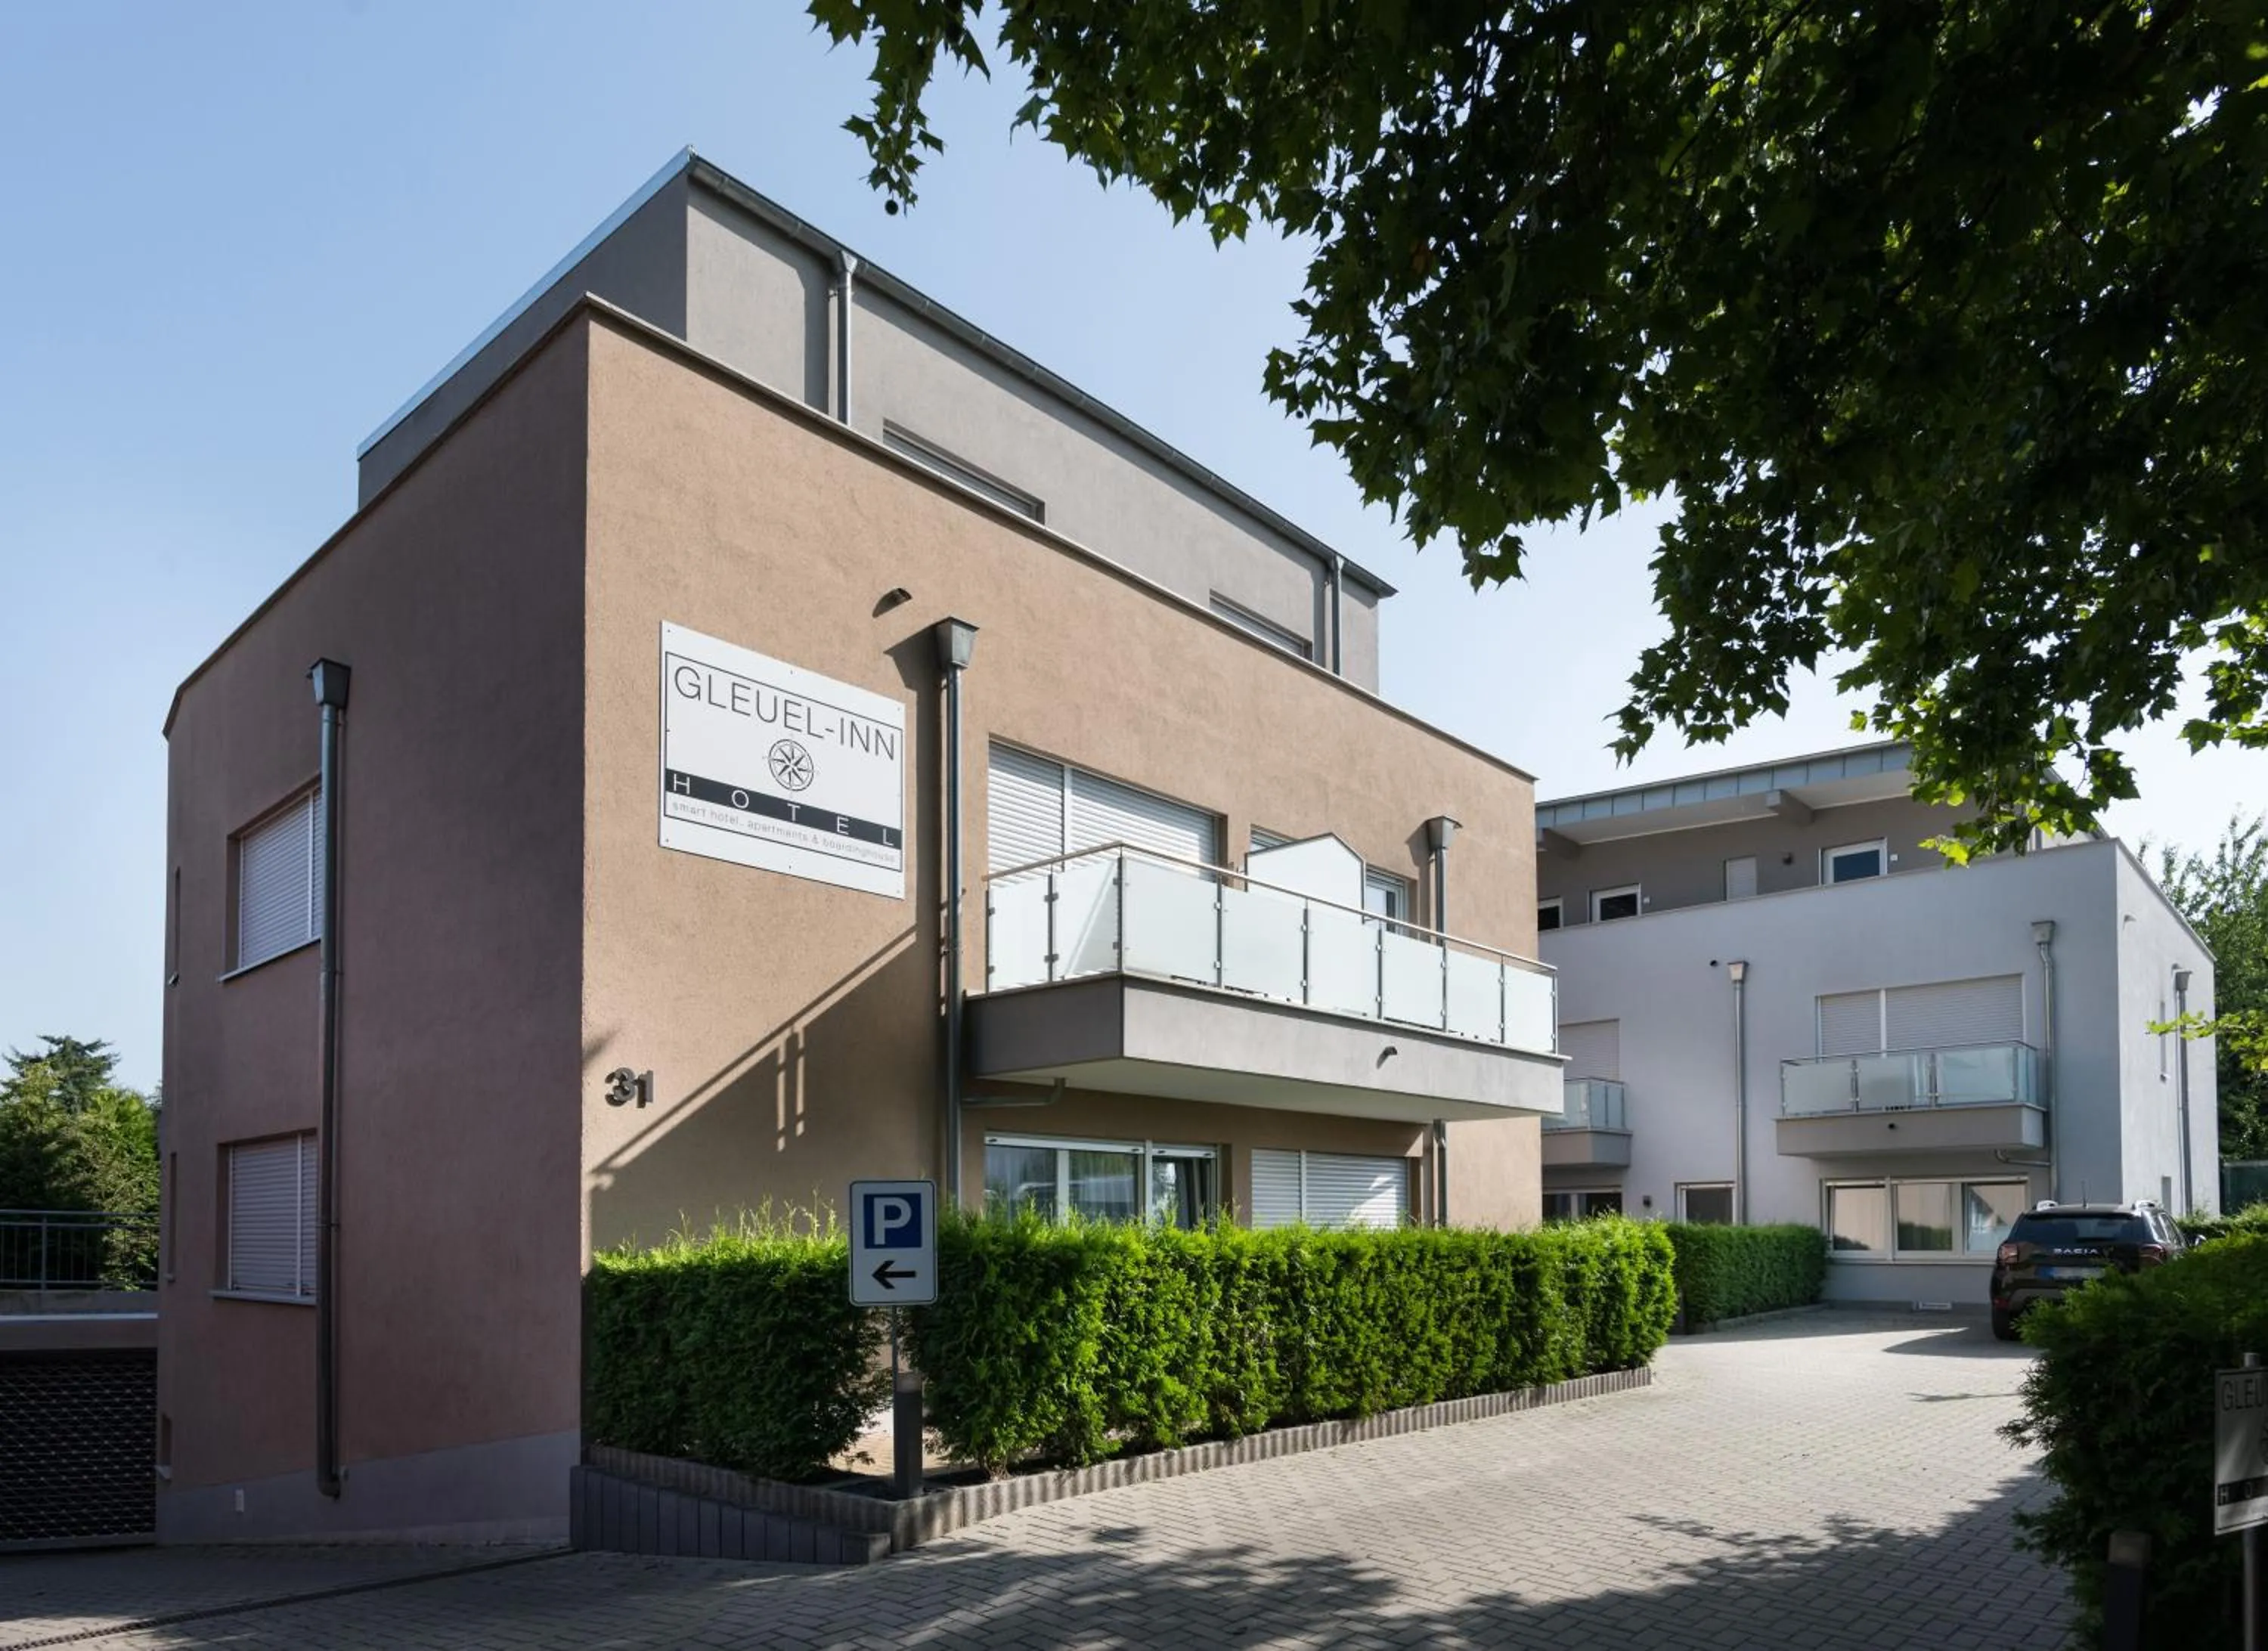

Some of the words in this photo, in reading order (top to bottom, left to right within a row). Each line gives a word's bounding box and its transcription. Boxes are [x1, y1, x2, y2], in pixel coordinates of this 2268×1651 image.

[674, 665, 895, 761] GLEUEL-INN
[672, 801, 706, 815] smart
[747, 820, 808, 842] apartments
[811, 834, 819, 844] &
[673, 773, 894, 846] HOTEL
[606, 1067, 653, 1105] 31
[873, 1196, 912, 1245] P
